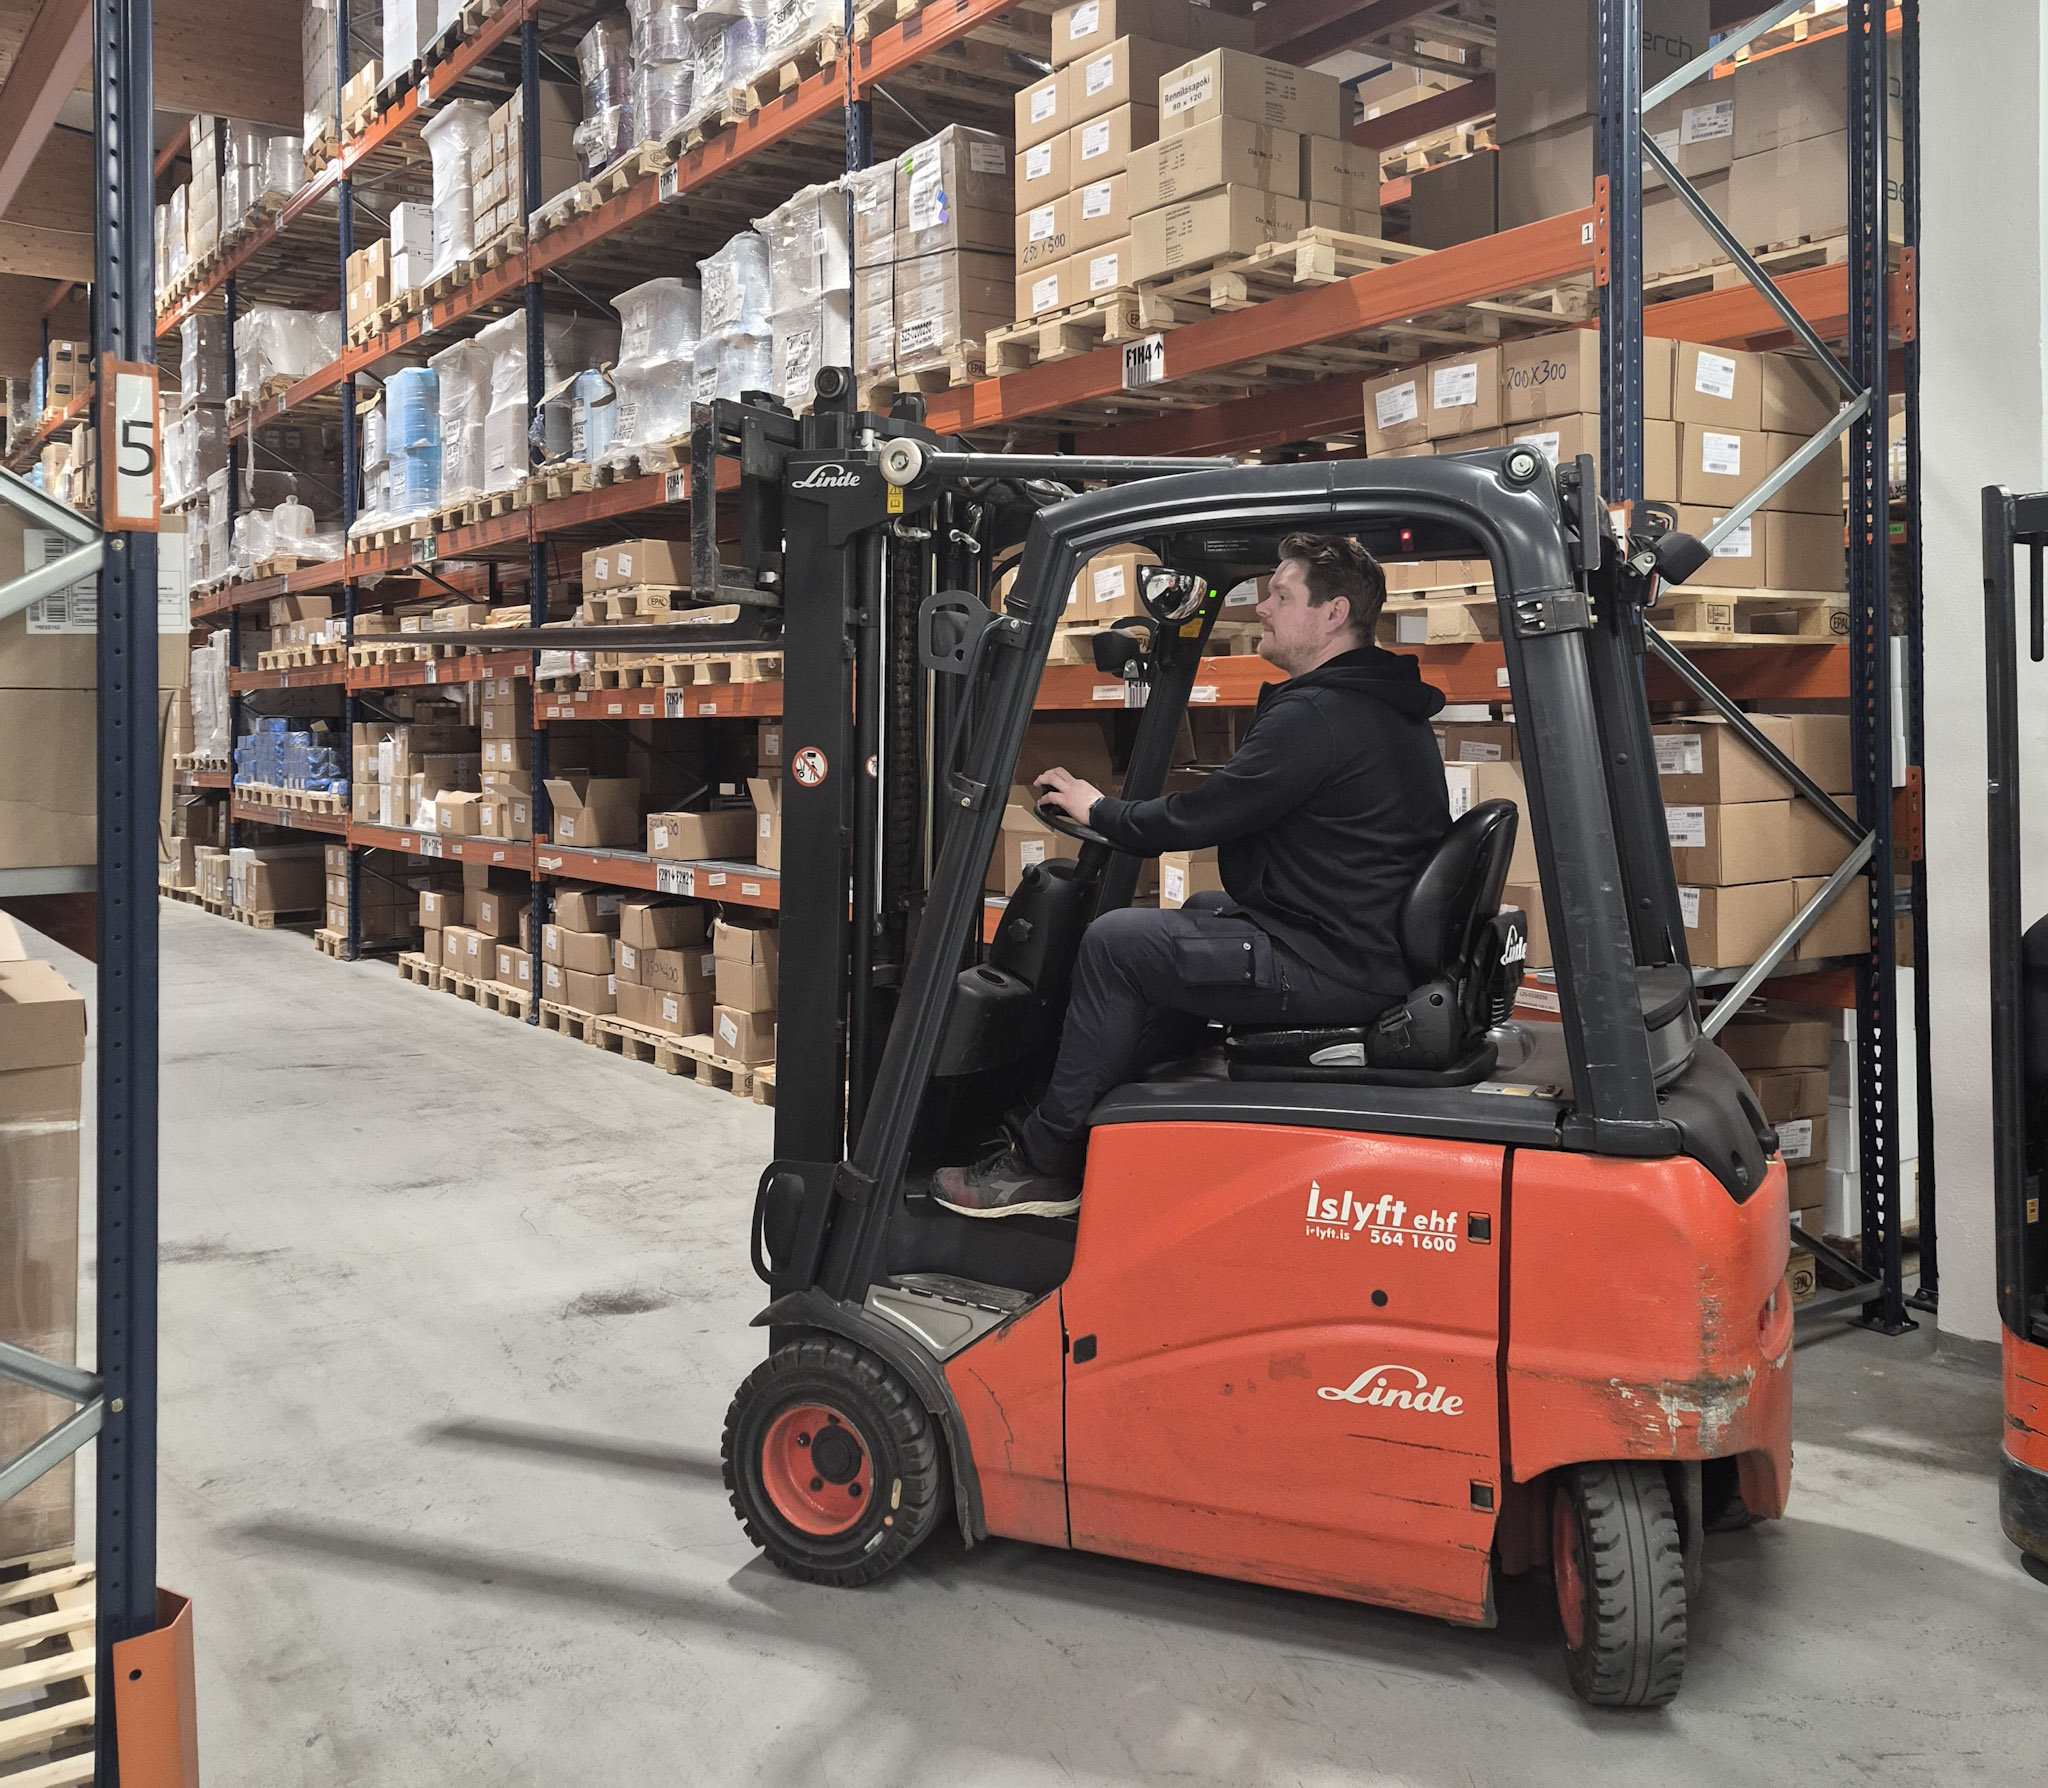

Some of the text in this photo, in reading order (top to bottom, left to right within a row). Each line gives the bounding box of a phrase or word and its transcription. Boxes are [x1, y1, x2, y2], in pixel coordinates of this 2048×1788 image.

[1190, 92, 1202, 104] 120
[1048, 233, 1066, 254] 500
[1584, 225, 1591, 241] 1
[1126, 344, 1152, 368] F1H4
[118, 420, 156, 477] 5
[792, 464, 860, 488] Linde
[1500, 924, 1527, 965] Linde
[1413, 1210, 1458, 1233] ehf
[1370, 1230, 1404, 1247] 564
[1412, 1234, 1457, 1253] 1600
[1317, 1365, 1464, 1416] Linde
